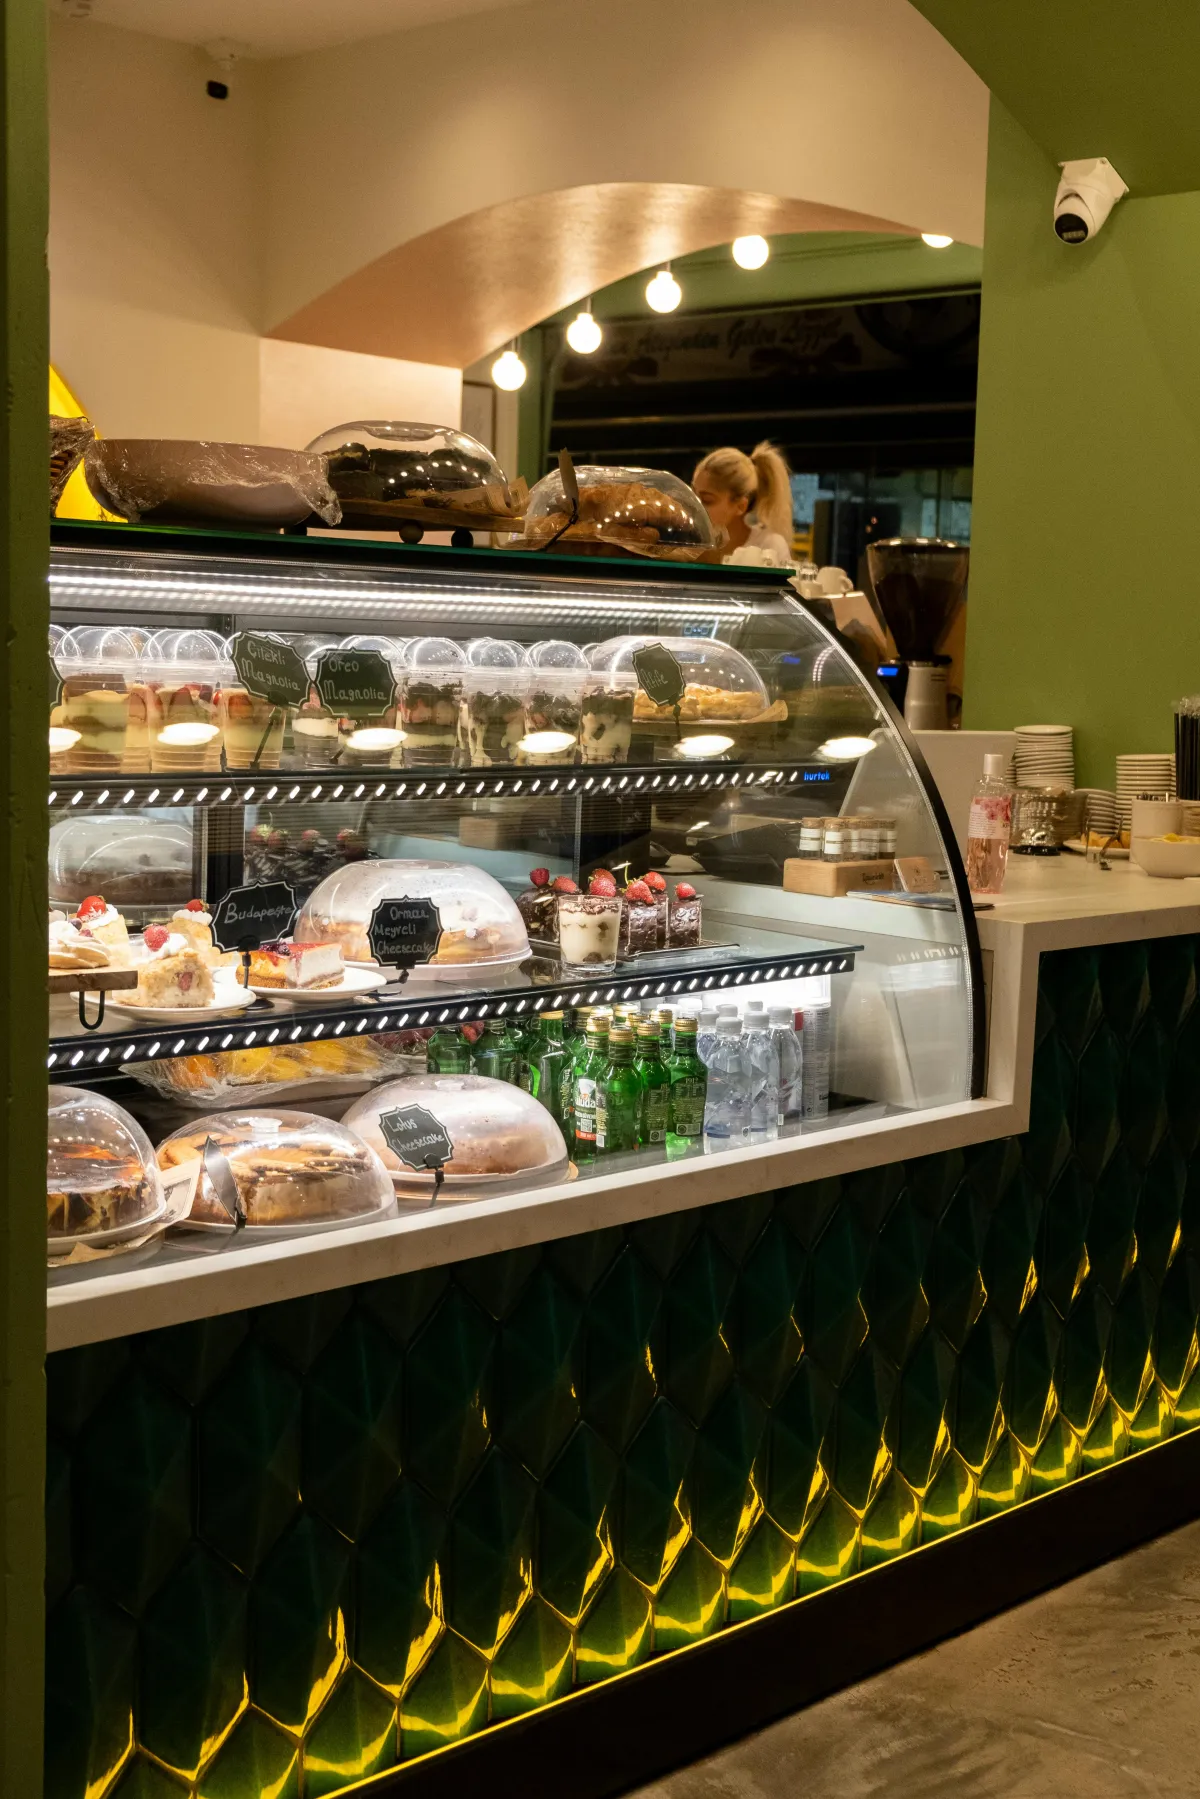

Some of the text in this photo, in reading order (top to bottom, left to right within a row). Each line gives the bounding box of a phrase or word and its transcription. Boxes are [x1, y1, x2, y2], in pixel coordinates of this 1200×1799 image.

[241, 657, 300, 691] Magnolia
[328, 657, 360, 673] Oreo
[323, 679, 388, 702] Magnolia
[376, 940, 436, 955] Cheesecake
[385, 1116, 418, 1133] Lotus
[390, 1132, 446, 1153] Cheesecake
